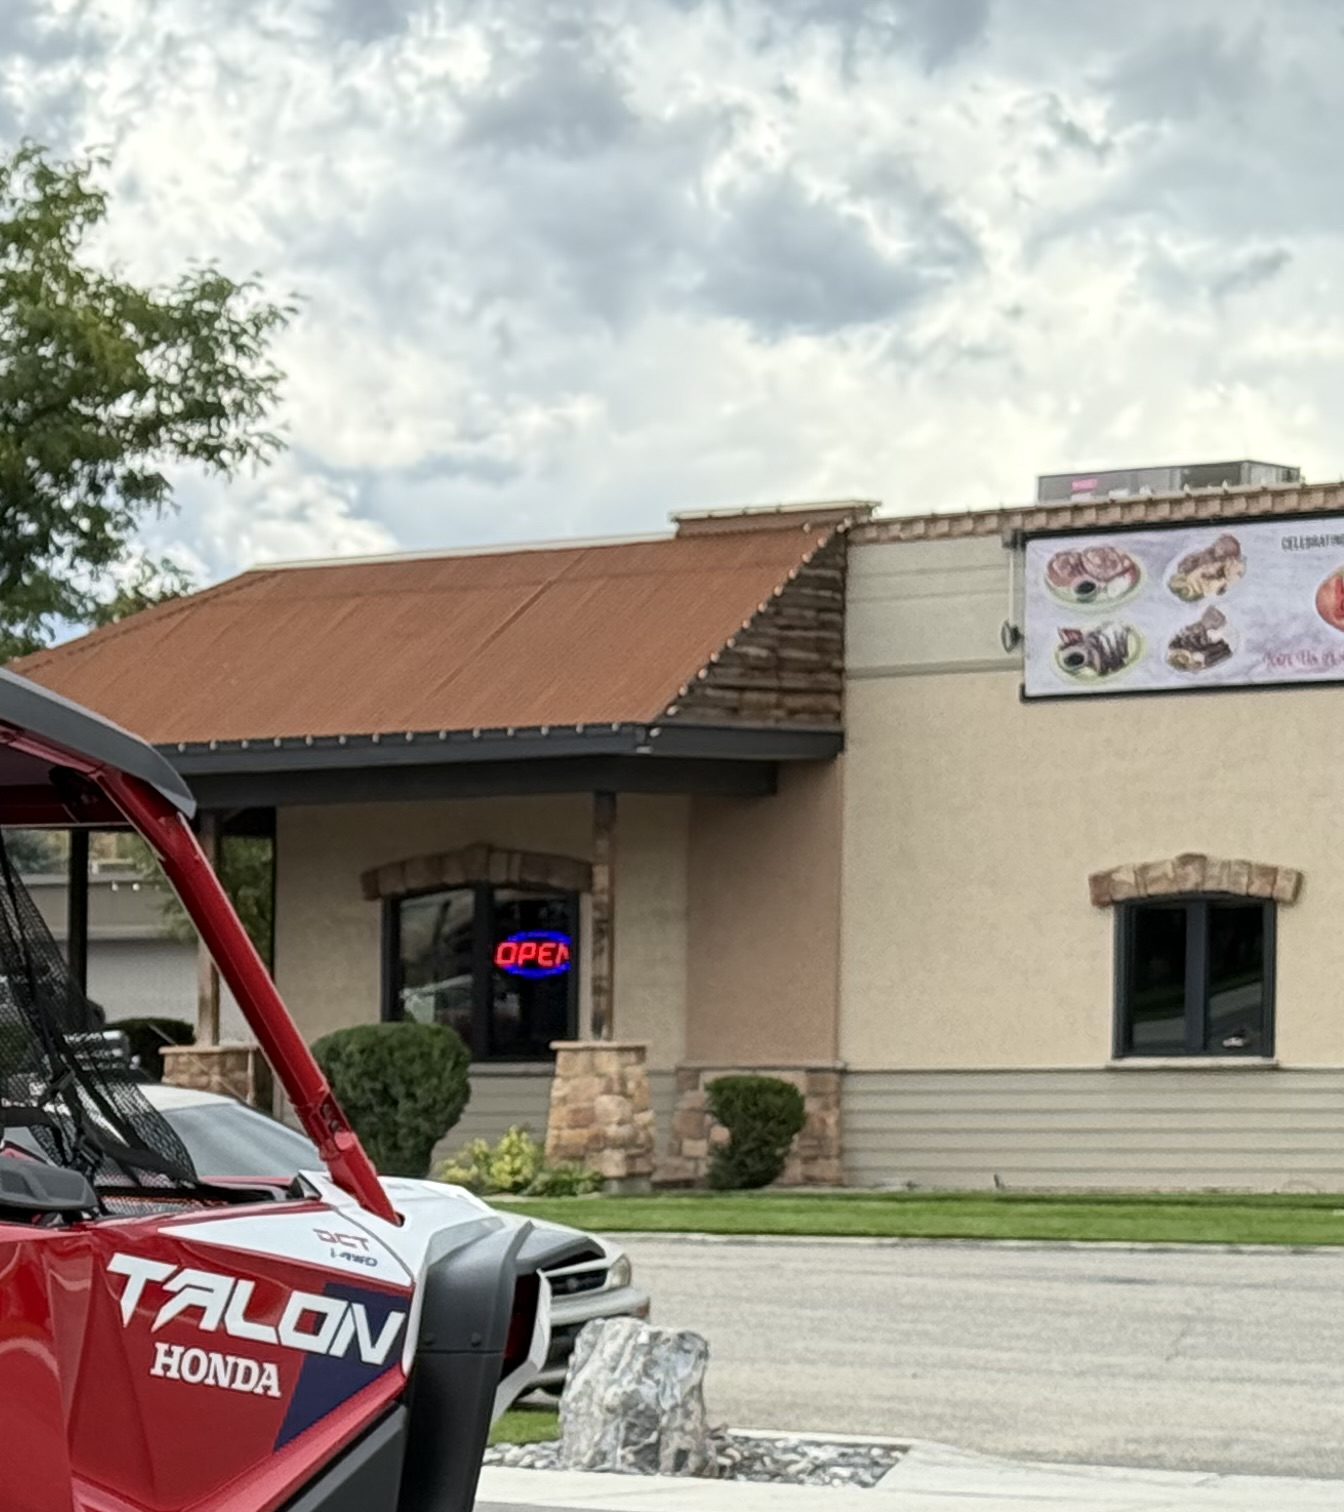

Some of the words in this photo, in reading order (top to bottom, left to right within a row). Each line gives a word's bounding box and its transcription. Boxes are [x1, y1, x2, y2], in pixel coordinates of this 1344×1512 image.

[312, 1228, 369, 1251] DCT
[107, 1252, 407, 1366] TALON
[150, 1341, 282, 1398] HONDA
